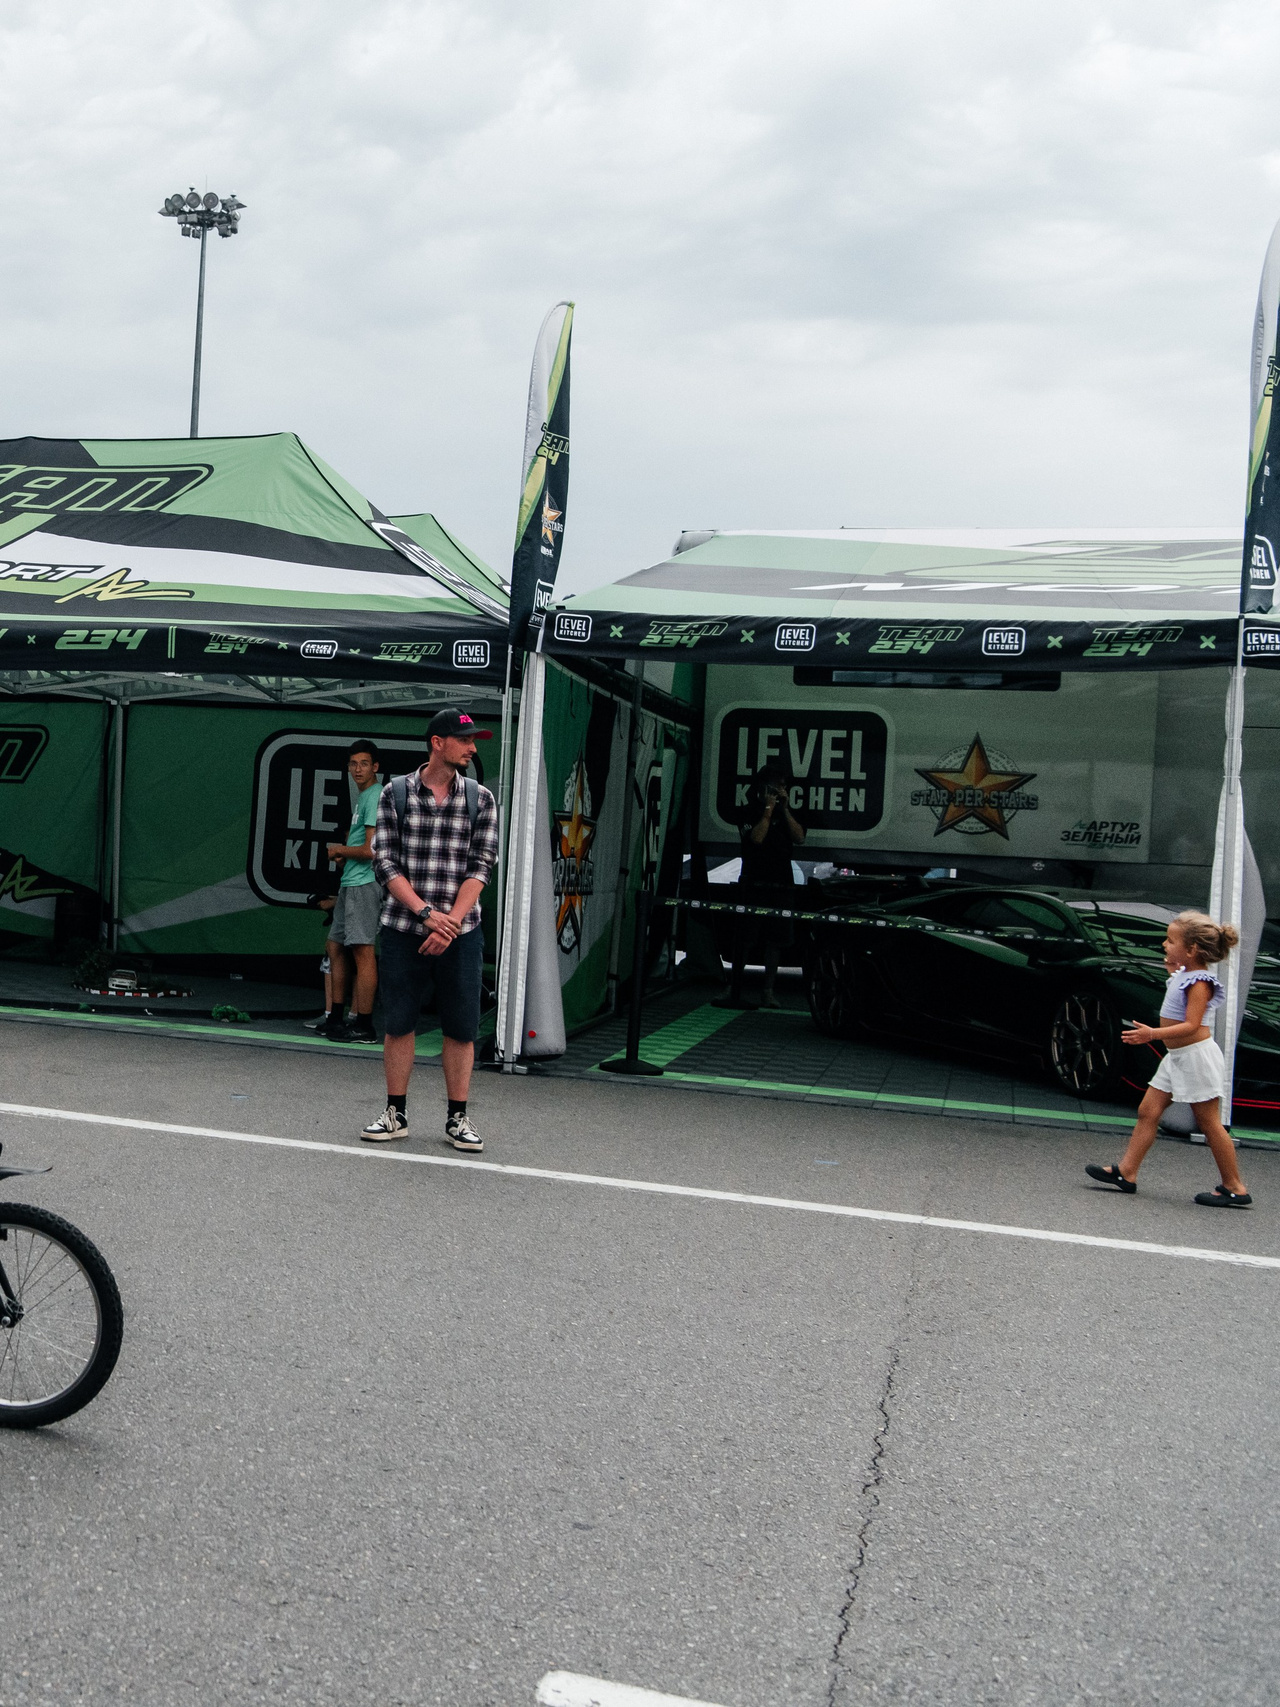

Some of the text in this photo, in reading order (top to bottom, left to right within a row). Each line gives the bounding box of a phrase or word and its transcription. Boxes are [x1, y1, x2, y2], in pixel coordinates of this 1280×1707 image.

[560, 618, 586, 631] LEVEL
[648, 621, 728, 635] TEAM
[55, 628, 149, 650] 234
[559, 629, 586, 638] KITCHEN
[781, 628, 811, 641] LEVEL
[878, 626, 965, 642] TEAM
[988, 632, 1019, 645] LEVEL
[1091, 627, 1185, 643] TEAM
[204, 642, 248, 654] 234
[639, 635, 700, 648] 234
[780, 639, 810, 647] KITCHEN
[868, 641, 932, 654] 234
[987, 643, 1019, 651] KITCHEN
[380, 642, 443, 655] TEAM
[458, 645, 485, 657] LEVEL
[1083, 642, 1154, 657] 234
[458, 656, 485, 664] KITCHEN
[738, 727, 867, 781] LEVEL
[735, 782, 867, 812] KCHEN
[910, 789, 949, 806] STAR
[989, 790, 1039, 810] STARS
[1086, 820, 1140, 833] АРТУР
[1060, 830, 1142, 845] ЗЕЛЕНЫЙ
